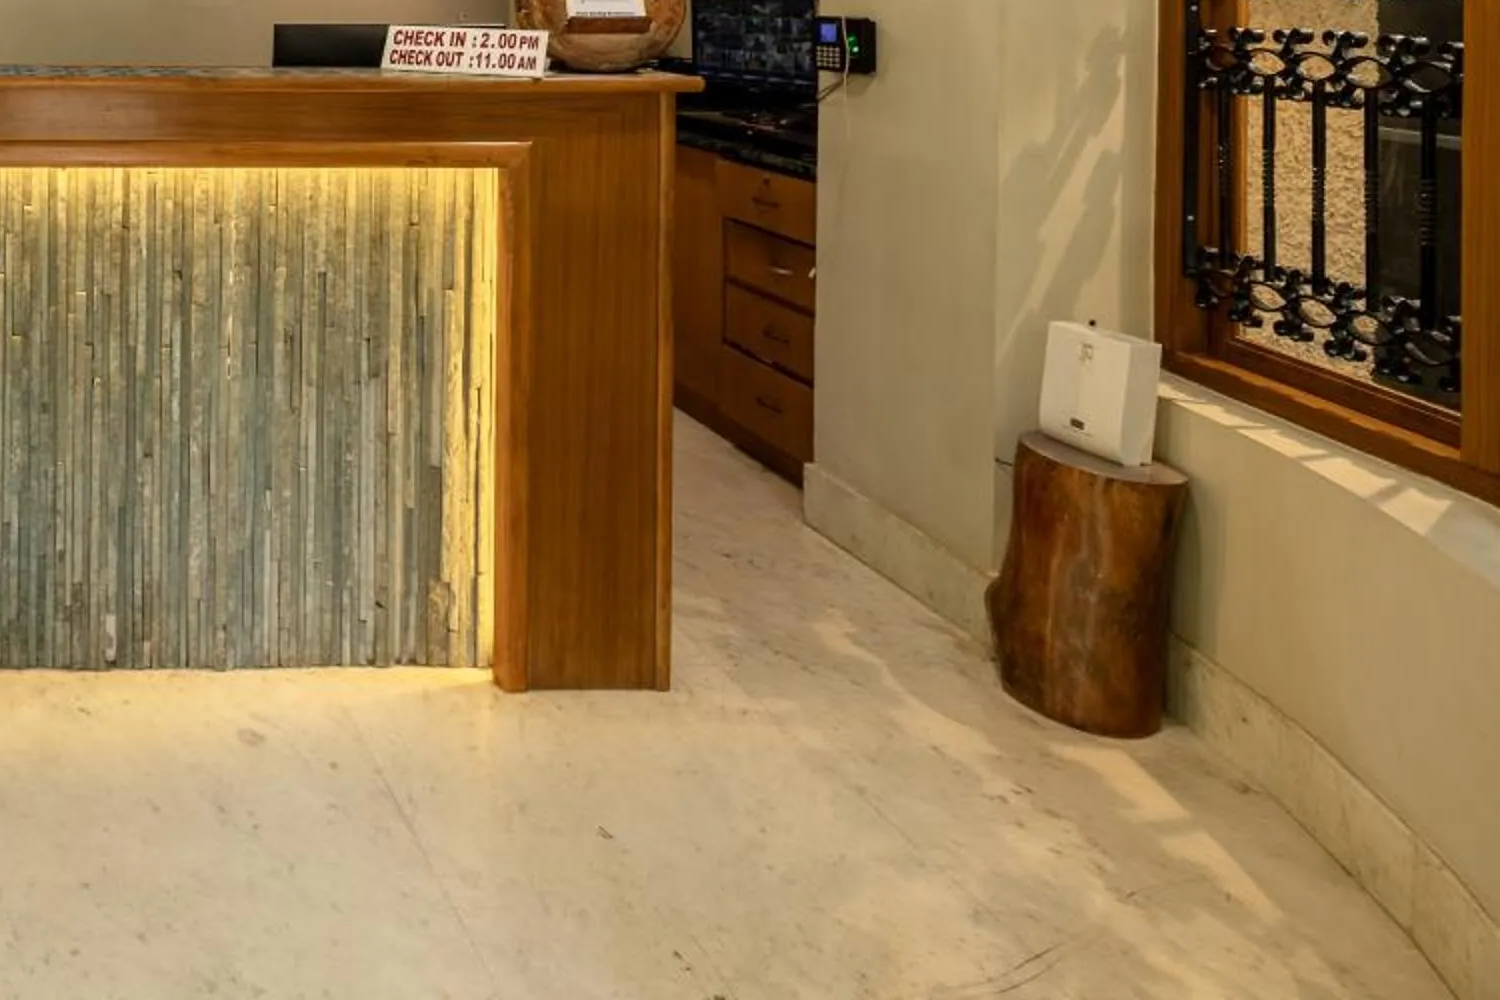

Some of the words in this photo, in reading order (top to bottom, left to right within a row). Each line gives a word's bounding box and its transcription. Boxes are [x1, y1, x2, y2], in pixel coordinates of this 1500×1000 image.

[393, 29, 446, 47] CHECK
[449, 31, 467, 47] IN
[389, 49, 433, 66] CHECK
[435, 51, 465, 67] OUT
